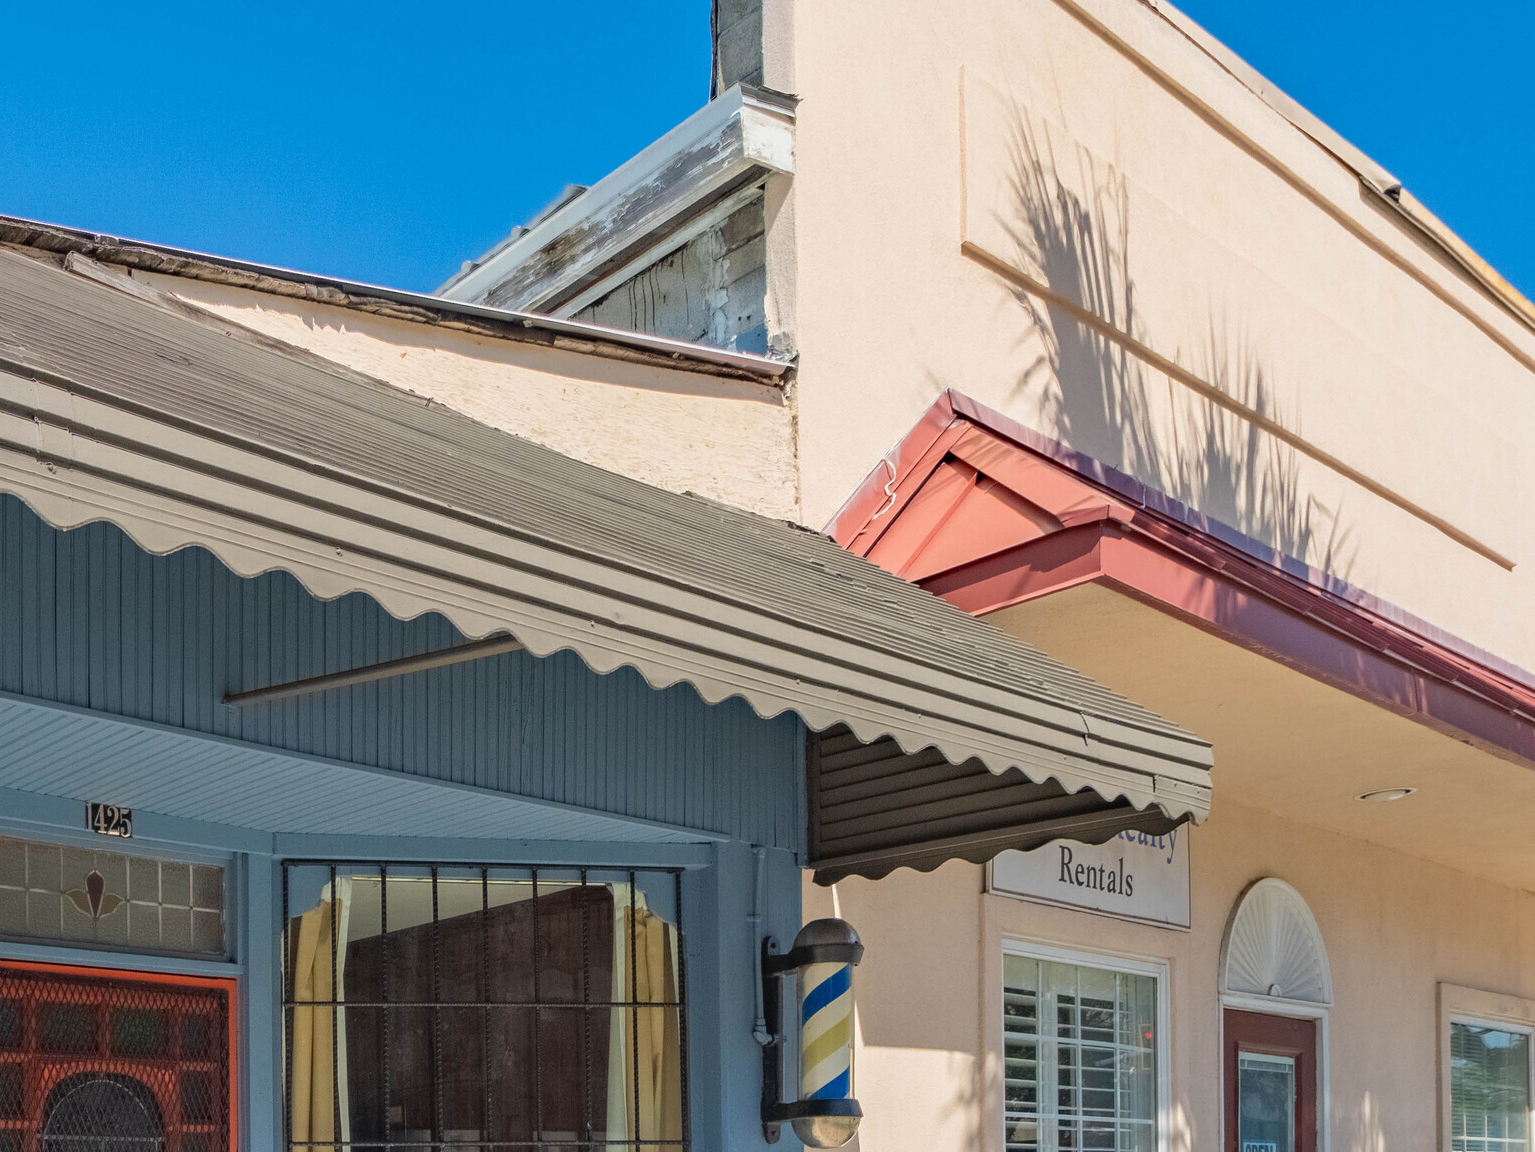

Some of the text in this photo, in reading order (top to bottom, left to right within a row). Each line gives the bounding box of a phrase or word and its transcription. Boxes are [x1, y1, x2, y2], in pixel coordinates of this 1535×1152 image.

[85, 801, 132, 838] 1425
[1117, 828, 1178, 865] eaty
[1058, 845, 1134, 897] Rentals
